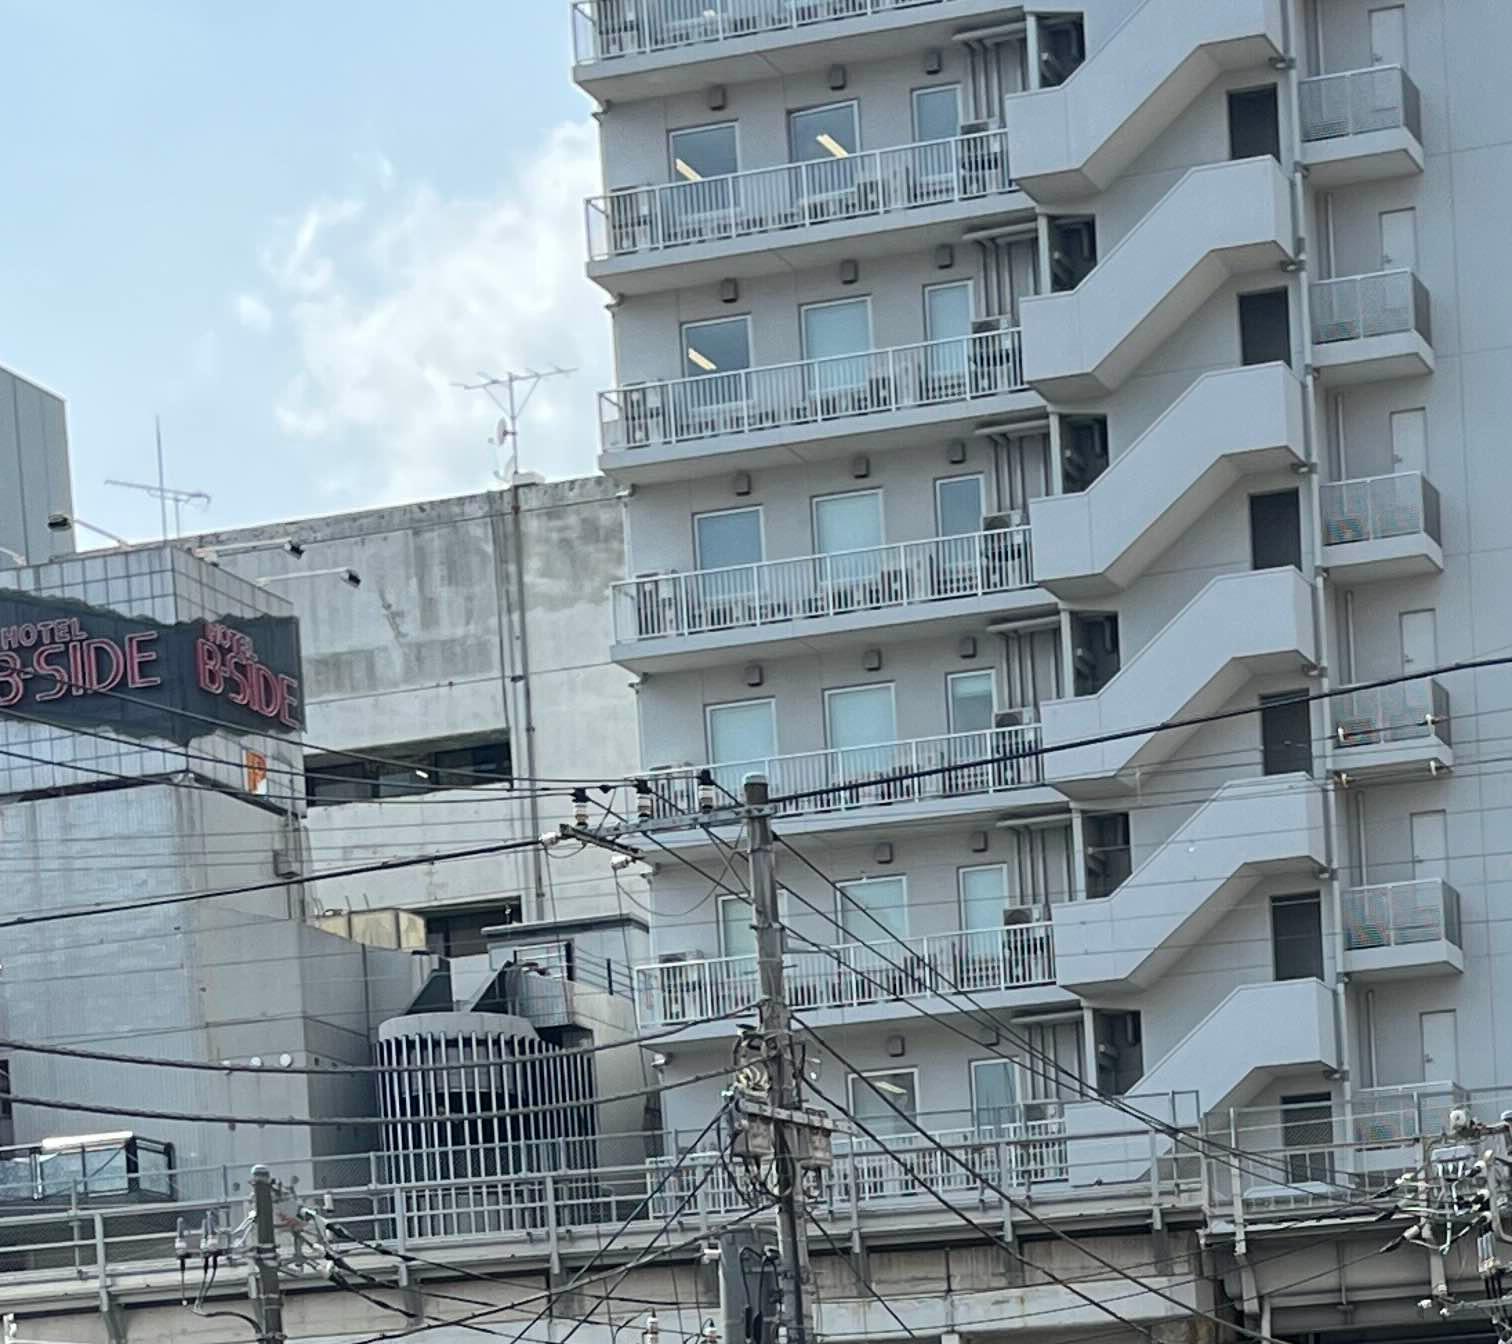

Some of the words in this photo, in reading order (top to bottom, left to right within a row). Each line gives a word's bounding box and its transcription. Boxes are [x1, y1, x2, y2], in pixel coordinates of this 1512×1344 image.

[1, 617, 88, 650] HOTEL
[205, 624, 258, 665] HOTEL
[197, 638, 299, 730] B-SIDE
